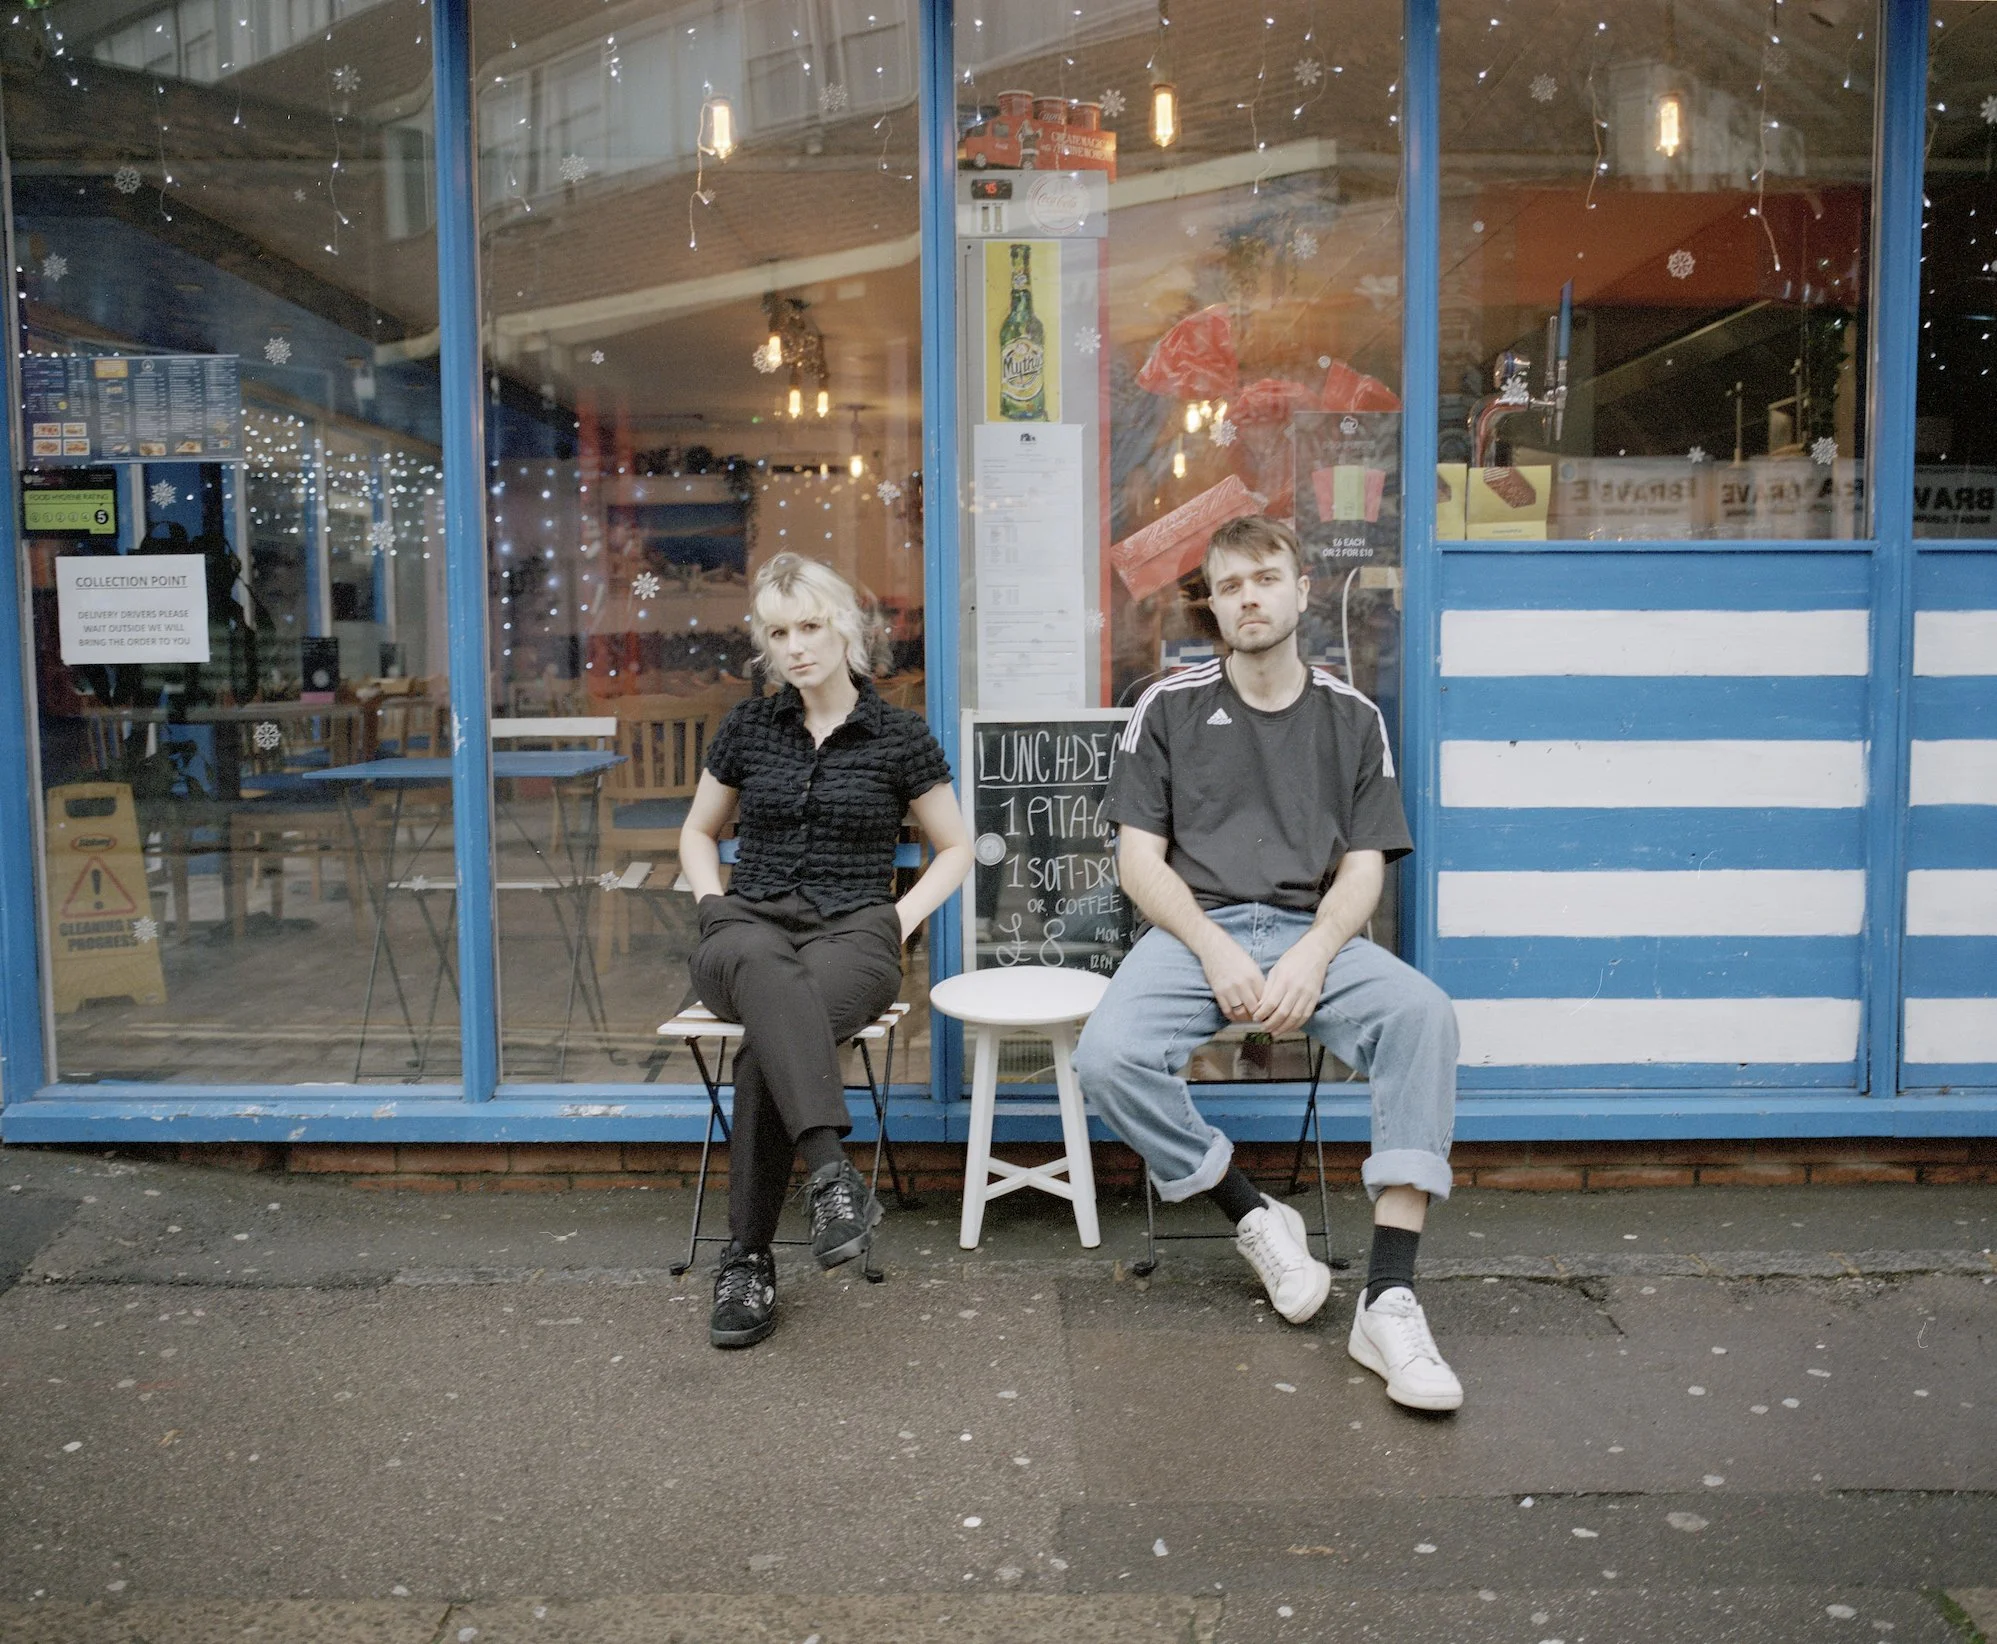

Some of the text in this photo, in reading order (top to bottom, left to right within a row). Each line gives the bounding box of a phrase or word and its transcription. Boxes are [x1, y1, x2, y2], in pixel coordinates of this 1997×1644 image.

[97, 511, 107, 523] 5
[1344, 537, 1366, 546] EACH
[1342, 548, 1359, 557] FOR
[75, 575, 188, 588] COLLECTION POINT
[78, 609, 189, 620] DELIVERY DRIVERS PLEASE
[83, 623, 184, 633] WAIT OUTSIDE WE WILL
[78, 637, 191, 647] BRING THE ORDER TO YOU
[1000, 796, 1021, 837] 1
[1005, 853, 1121, 892] 1 SOFT-DRI
[1055, 893, 1123, 916] COFFEE
[59, 919, 124, 937] CLEANING
[67, 934, 138, 952] PROGRESS
